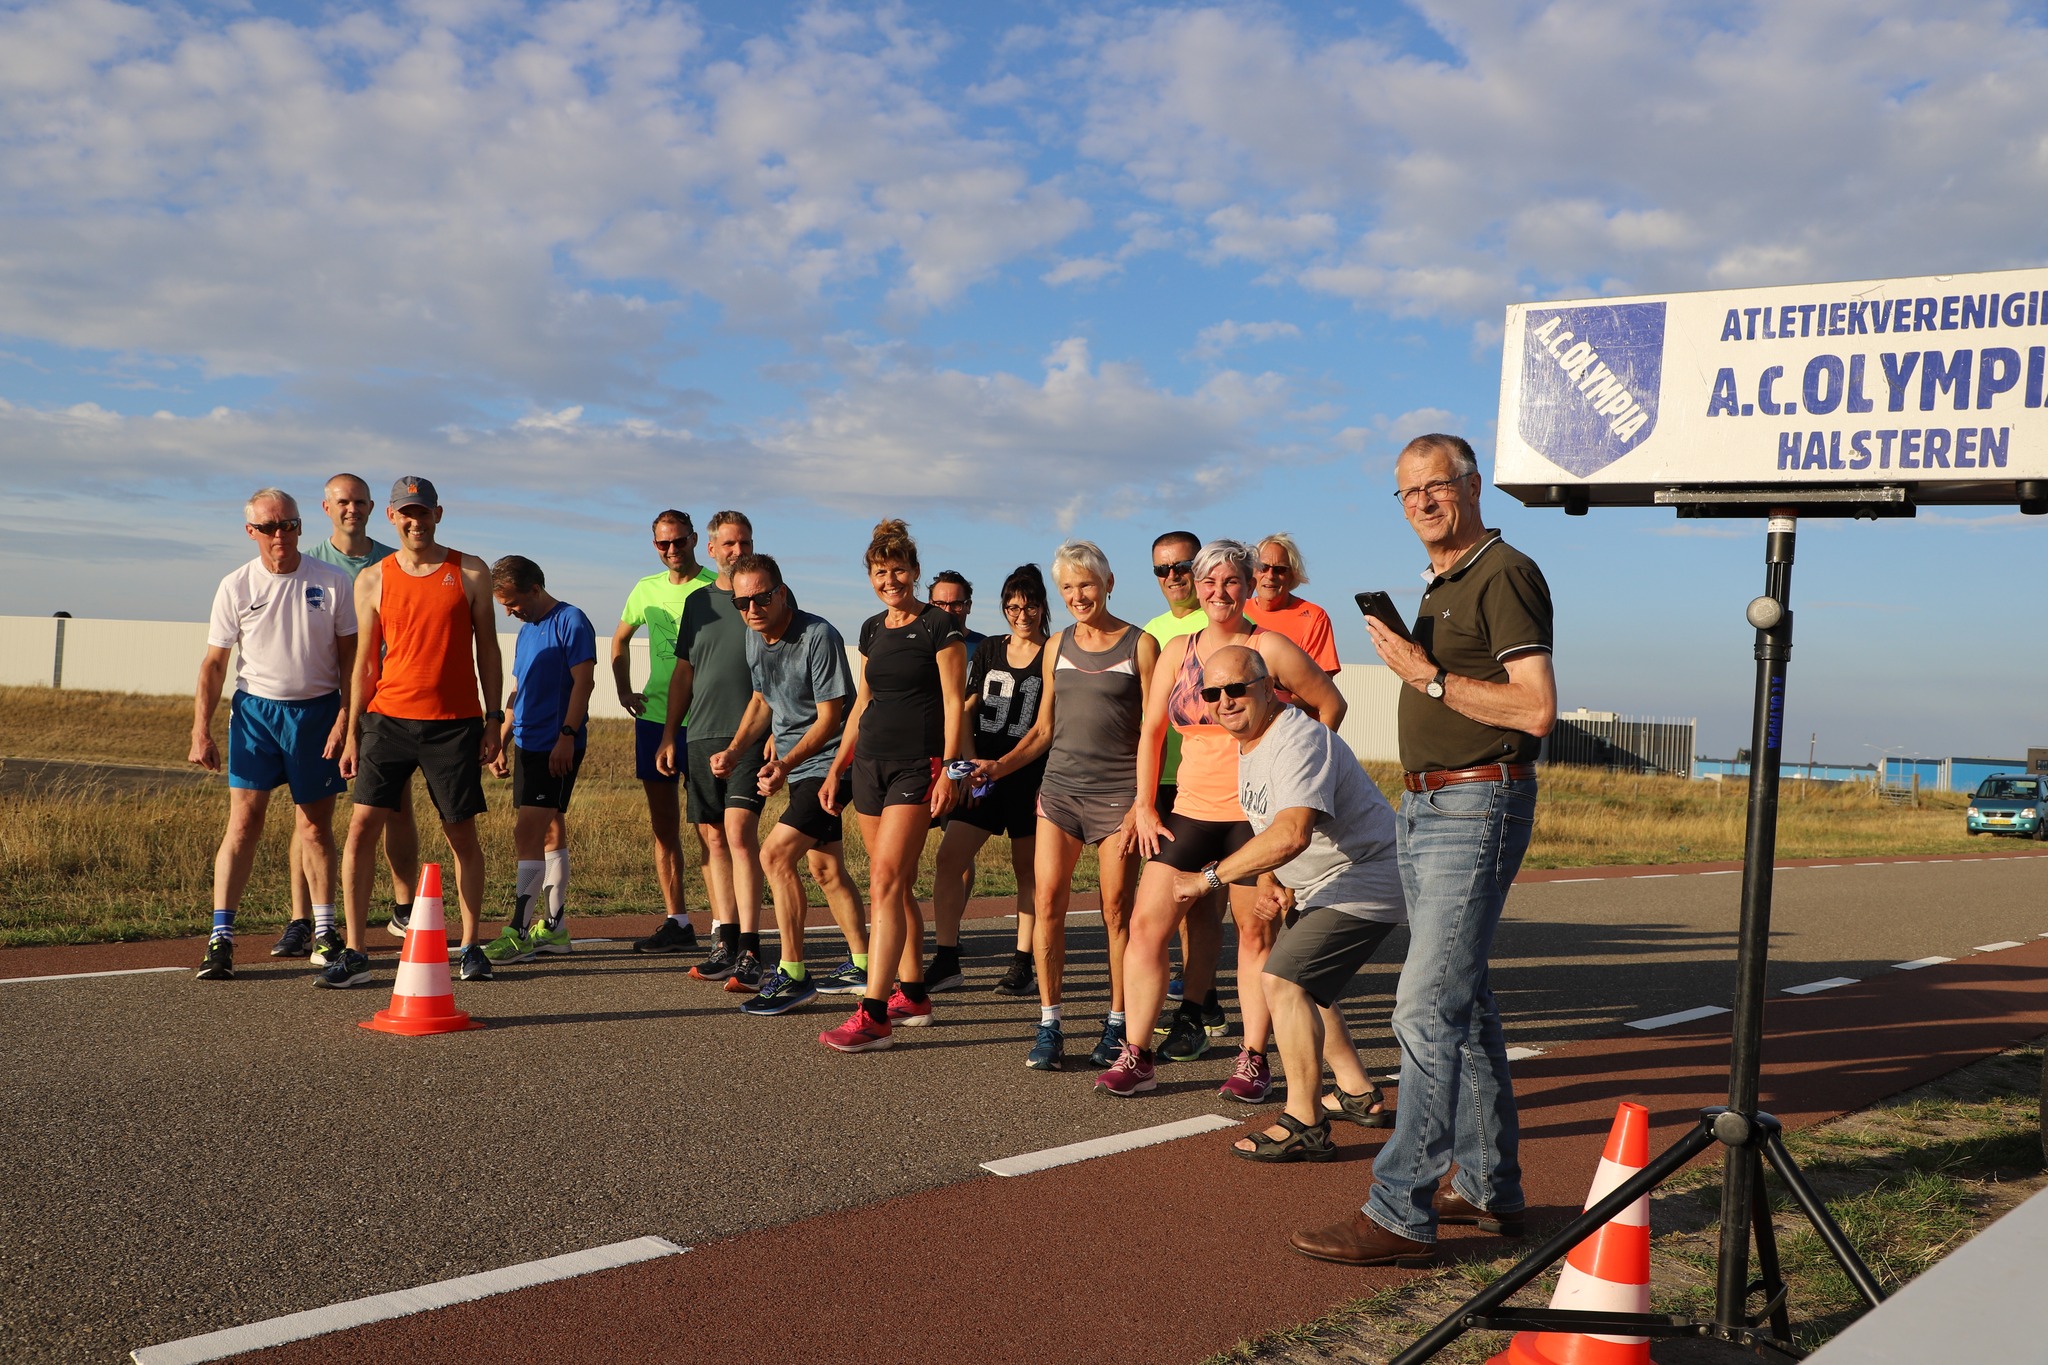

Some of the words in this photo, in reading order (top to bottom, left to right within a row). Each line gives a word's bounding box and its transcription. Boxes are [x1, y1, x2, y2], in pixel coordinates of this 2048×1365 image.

[1720, 290, 2048, 341] ATLETIEKVERENIGI
[1706, 346, 2048, 417] A.C.OLYMPI
[1777, 426, 2010, 471] HALSTEREN
[979, 669, 1042, 738] 91
